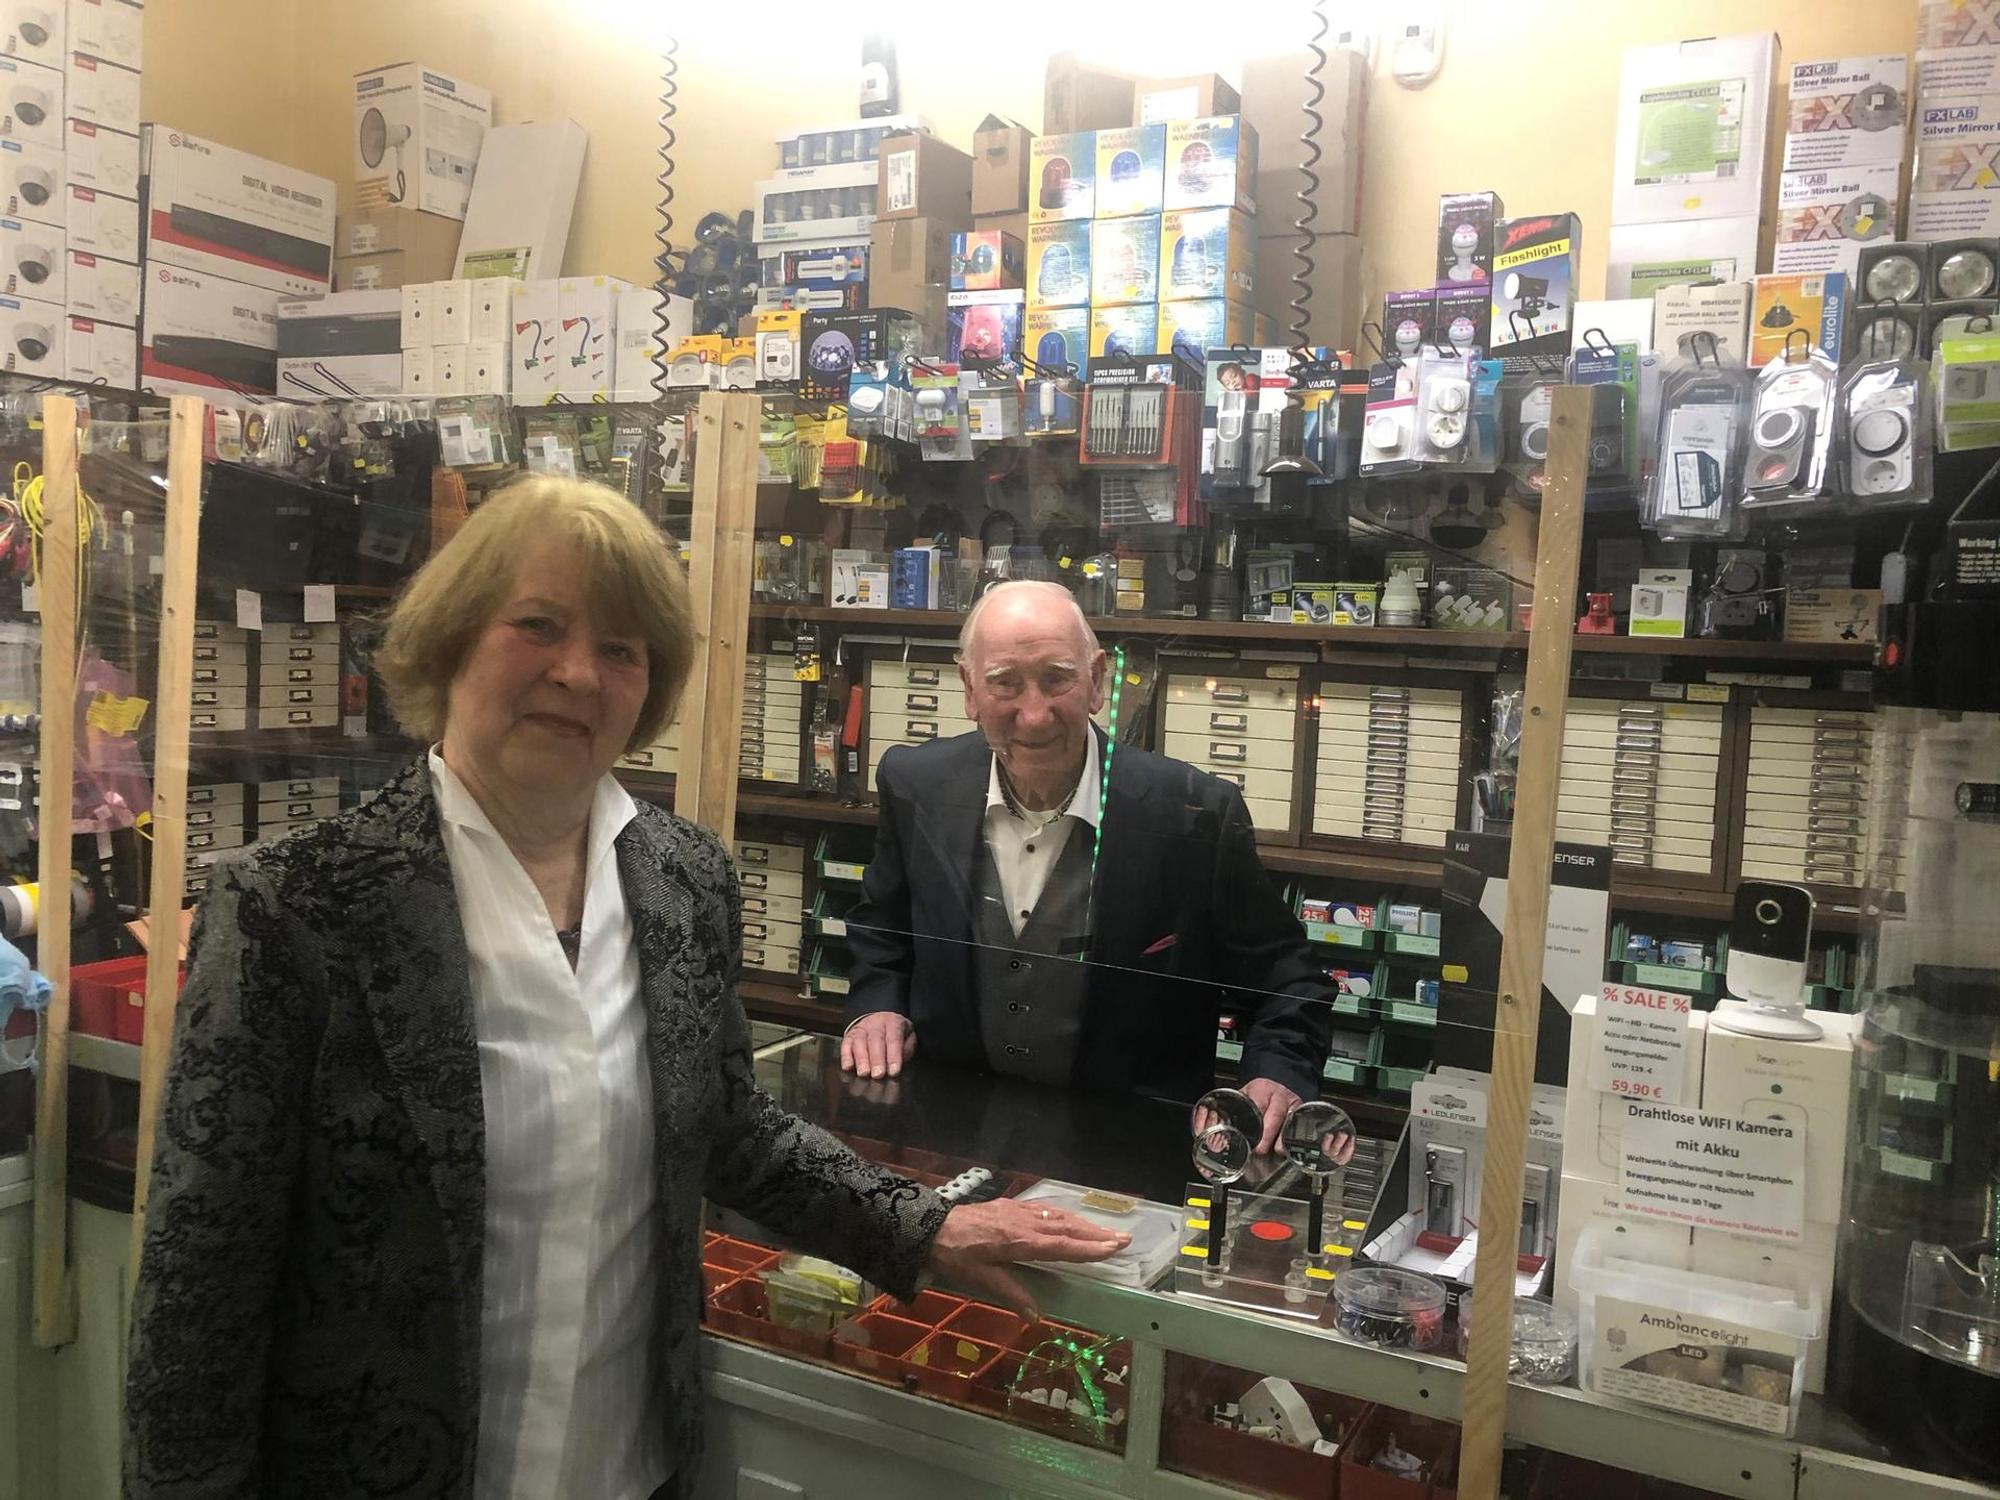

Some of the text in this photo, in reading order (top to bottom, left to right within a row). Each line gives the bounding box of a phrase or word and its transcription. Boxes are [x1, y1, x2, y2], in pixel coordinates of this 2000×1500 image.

[1793, 73, 1870, 88] Silver Mirror Ball
[1923, 123, 1993, 136] Silver Mirror
[242, 175, 268, 192] DIGITAL
[1810, 187, 1840, 196] Mirror
[1842, 184, 1860, 193] Ball
[1501, 243, 1562, 266] Flashlight
[232, 306, 258, 321] DIGITAL
[813, 317, 828, 326] Party
[1824, 295, 1839, 350] eurolite
[1108, 368, 1135, 376] PRECISION
[1307, 379, 1336, 389] VARTA
[1553, 853, 1596, 866] ENSER
[1303, 911, 1318, 921] 25
[1359, 908, 1371, 929] 25
[1391, 908, 1417, 917] PHILIPS
[1603, 987, 1689, 1013] % SALE %
[1649, 1022, 1677, 1033] Kamera
[1622, 1033, 1638, 1041] oder
[1604, 1045, 1668, 1061] Bewegungsmelder
[1612, 1080, 1664, 1098] 59,90 €
[1431, 1109, 1476, 1122] LEDLENSER
[1628, 1105, 1793, 1139] Drahtlose WIFI Kamera
[1529, 1128, 1562, 1139] LENSER
[1676, 1139, 1740, 1159] mit Akku
[1626, 1154, 1793, 1186] Weltweite Überwachung über Smartphon
[1626, 1170, 1755, 1198] Bewegungsmelder mit Nachricht
[1625, 1187, 1665, 1200] Aufnahme
[1667, 1194, 1678, 1202] bis
[1704, 1200, 1723, 1210] Tage
[1625, 1202, 1638, 1211] Wir
[1694, 1214, 1707, 1223] die
[1709, 1217, 1740, 1229] Kamera
[1640, 1313, 1749, 1346] Ambiancelight
[1681, 1347, 1703, 1358] LED
